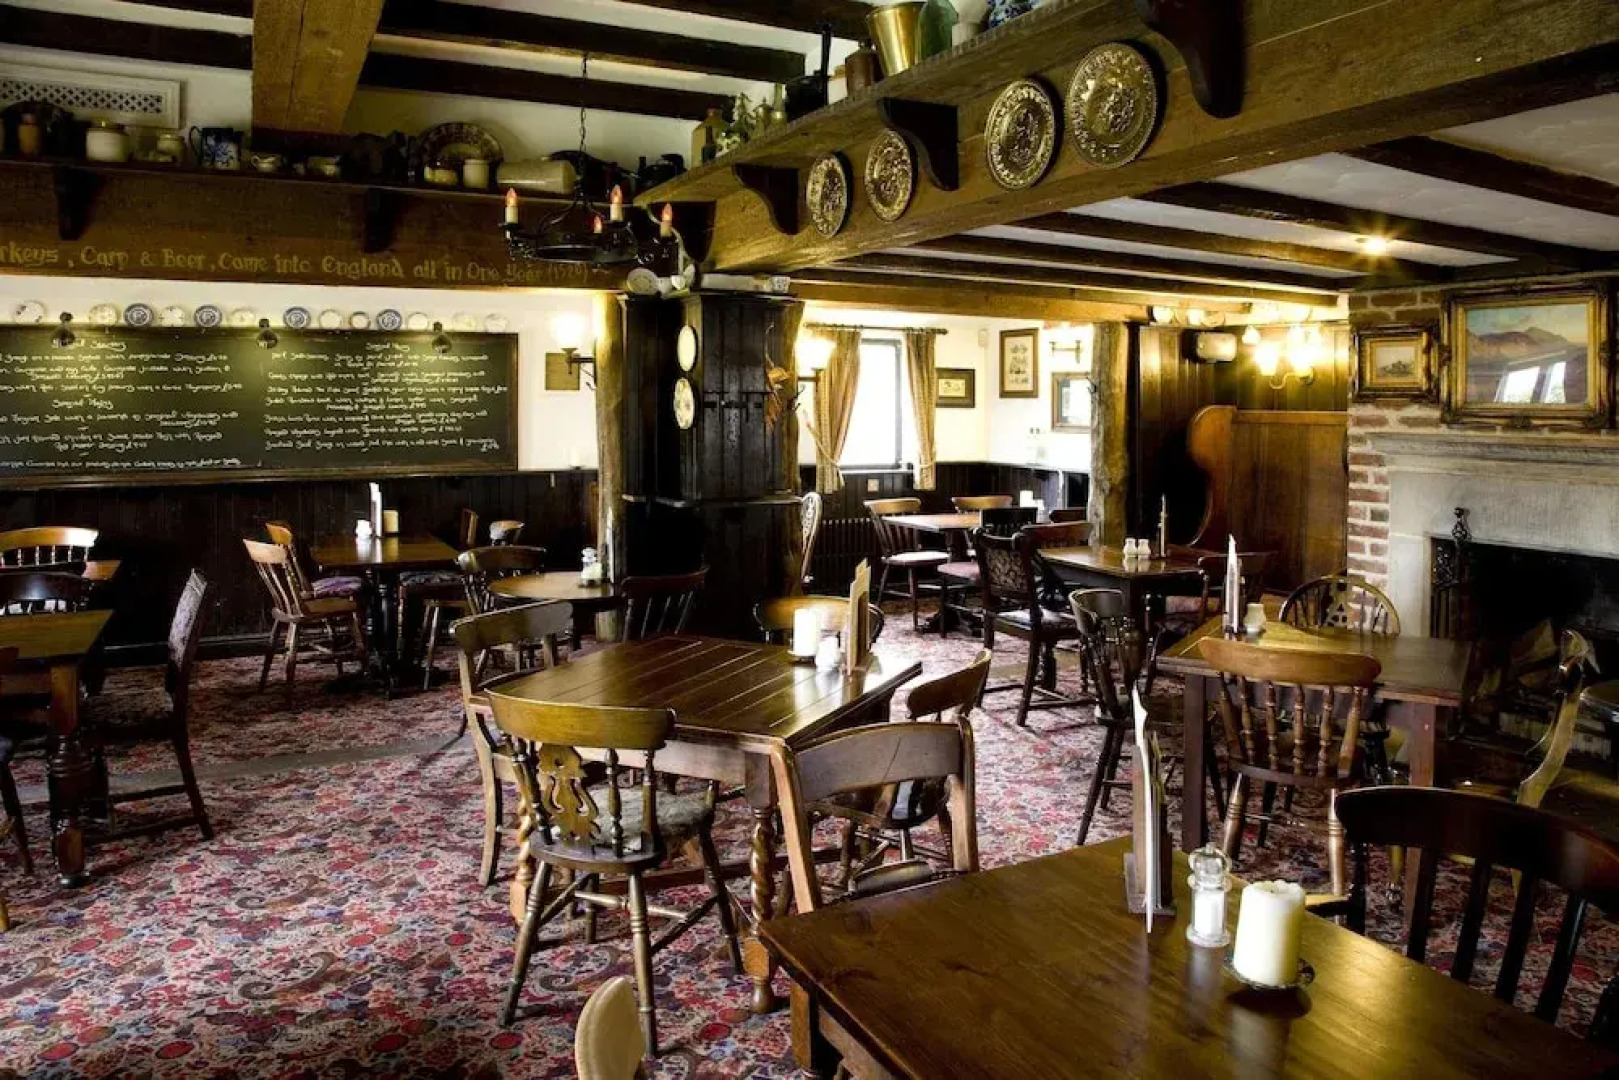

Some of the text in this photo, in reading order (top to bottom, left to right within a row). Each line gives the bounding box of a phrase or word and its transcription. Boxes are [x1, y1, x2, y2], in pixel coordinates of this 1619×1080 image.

[80, 245, 129, 271] Carp
[141, 250, 154, 267] &
[321, 255, 404, 280] England
[413, 259, 438, 279] all
[443, 261, 462, 281] in
[467, 261, 500, 281] One
